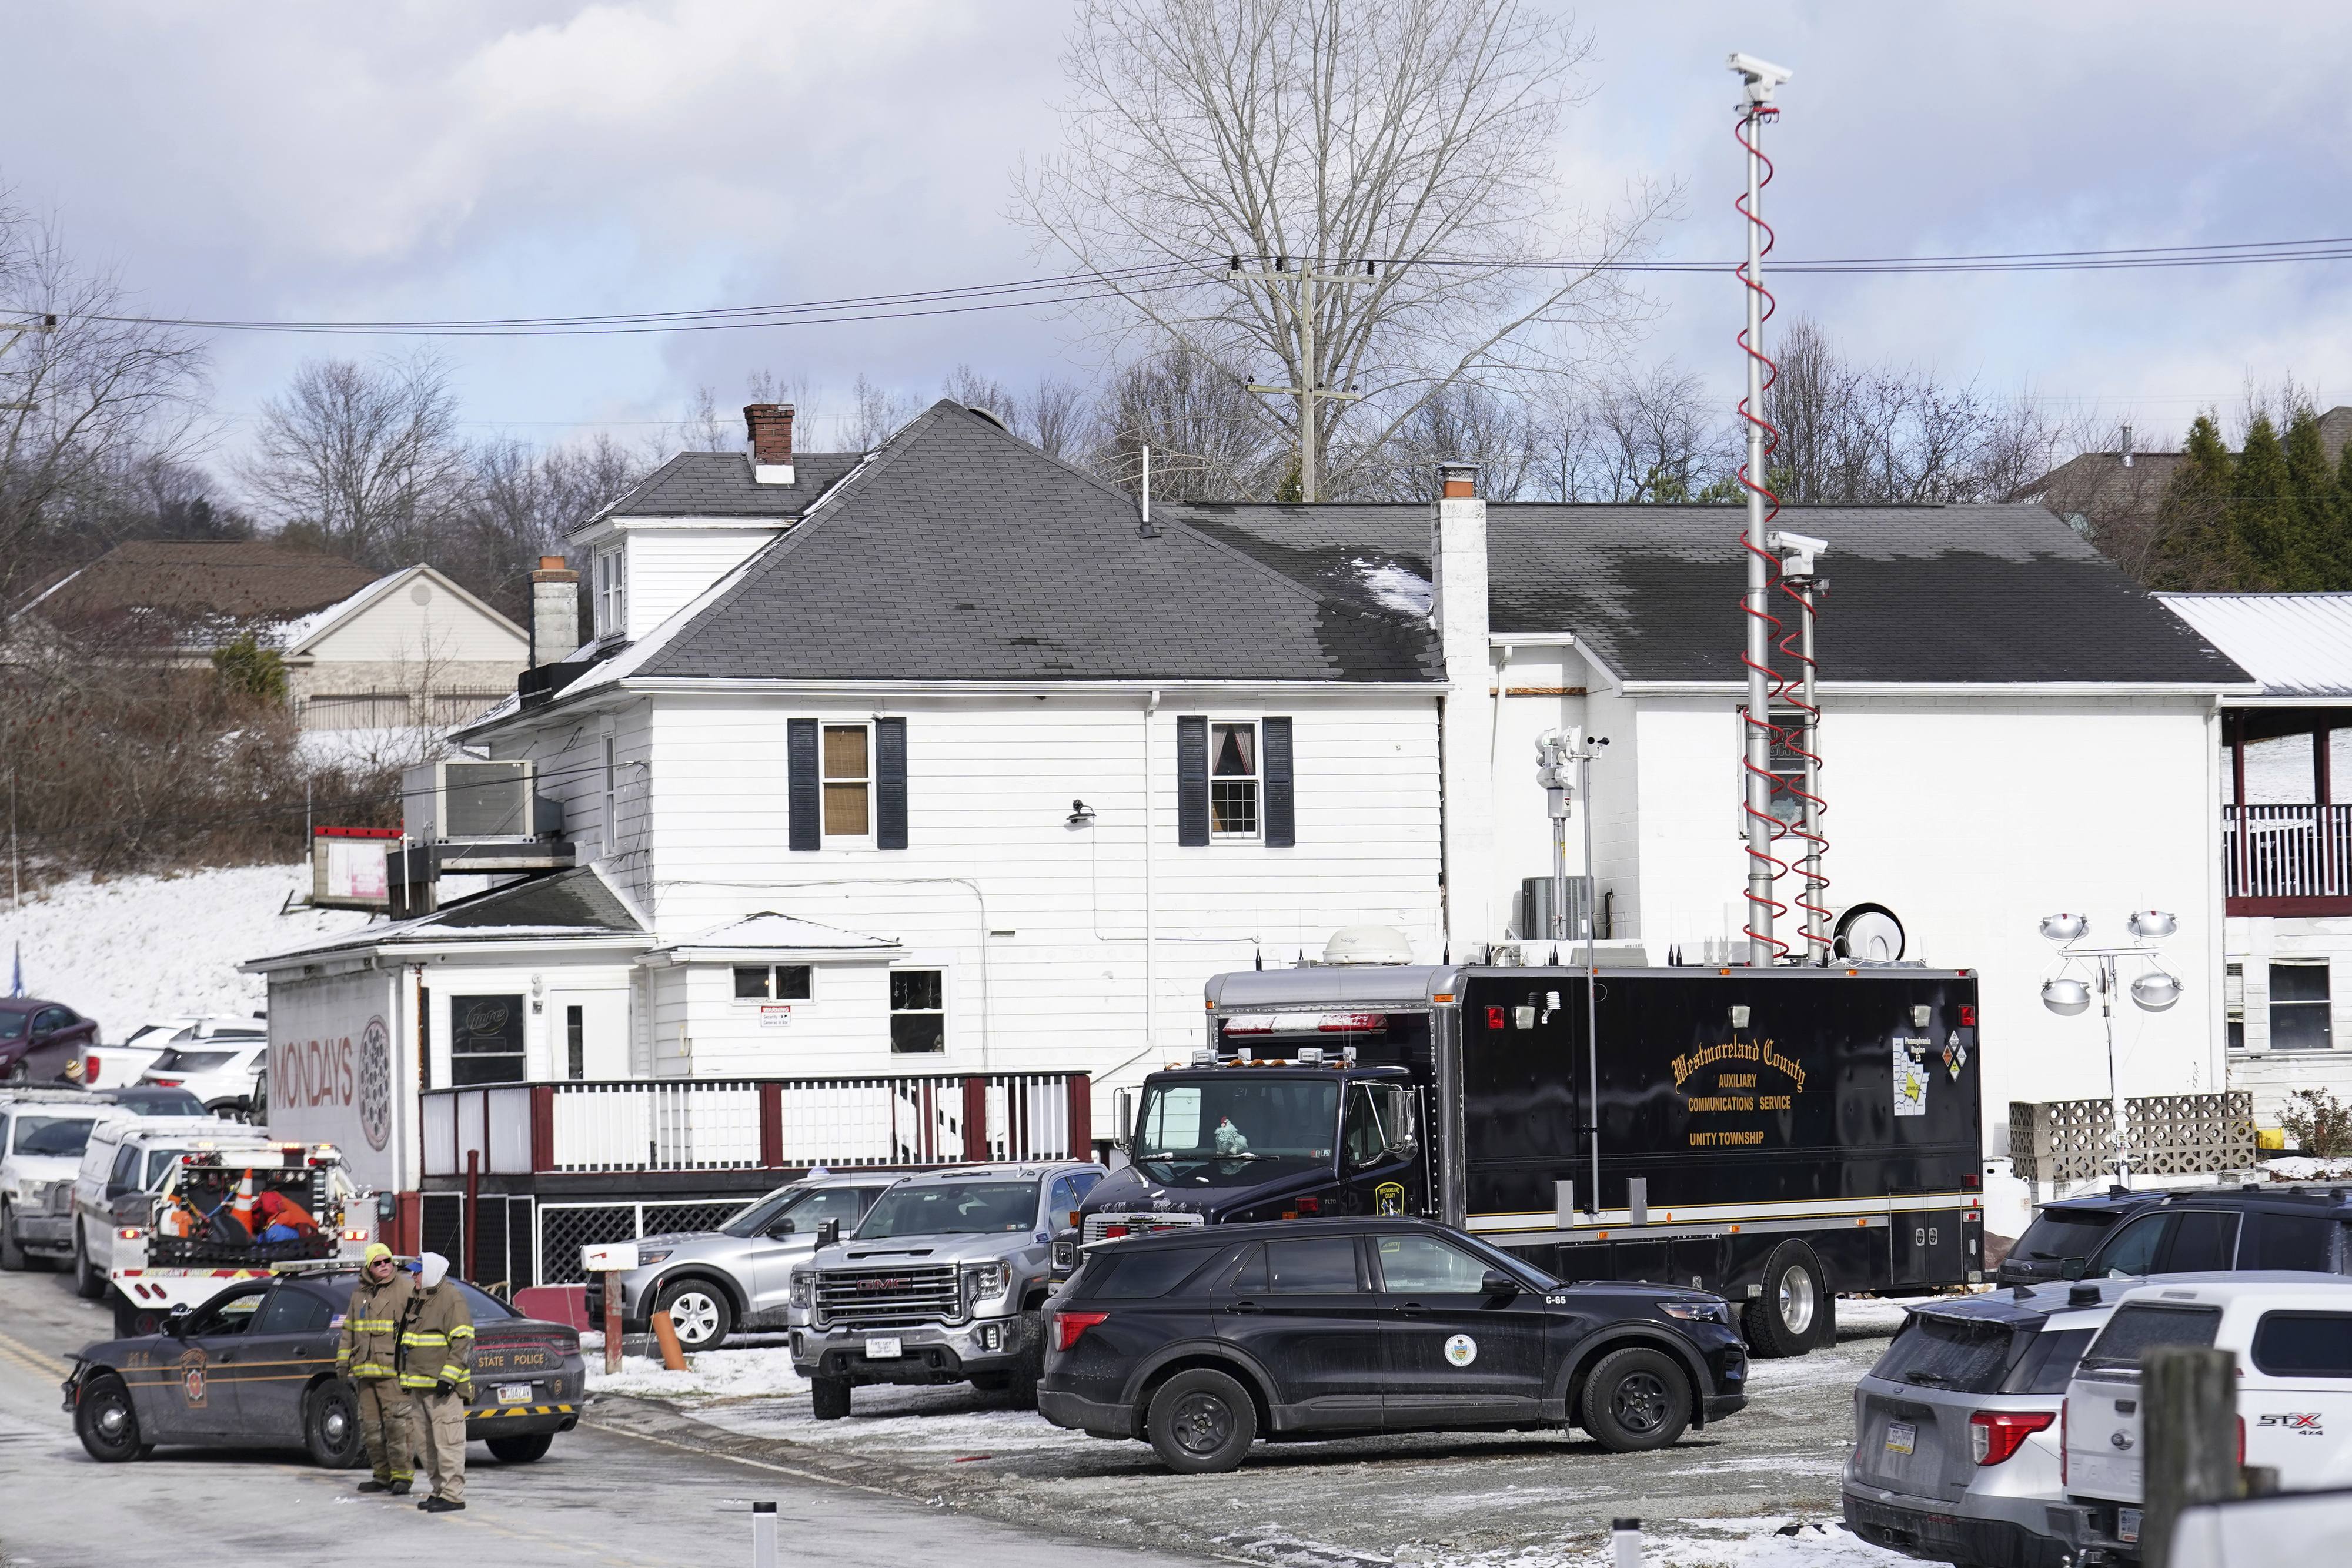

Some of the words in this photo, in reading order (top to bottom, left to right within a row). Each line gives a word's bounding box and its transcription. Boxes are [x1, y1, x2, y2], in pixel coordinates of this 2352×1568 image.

[1905, 1037, 1931, 1045] Pennsylvania
[1911, 1045, 1926, 1054] Region
[1671, 1033, 1760, 1094] Westmoreland
[1763, 1038, 1806, 1094] County
[273, 1036, 353, 1110] MONDAYS
[1719, 1074, 1757, 1088] AUXILIARY
[1688, 1096, 1753, 1111] COMMUNICATIONS
[1759, 1095, 1791, 1110] SERVICE
[1689, 1133, 1717, 1146] UNITY
[1718, 1131, 1764, 1145] TOWNSHIP
[857, 1277, 911, 1290] GMC
[1546, 1296, 1566, 1305] C-65
[478, 1356, 504, 1368] STATE
[514, 1353, 544, 1365] POLICE
[2257, 1412, 2323, 1429] STX
